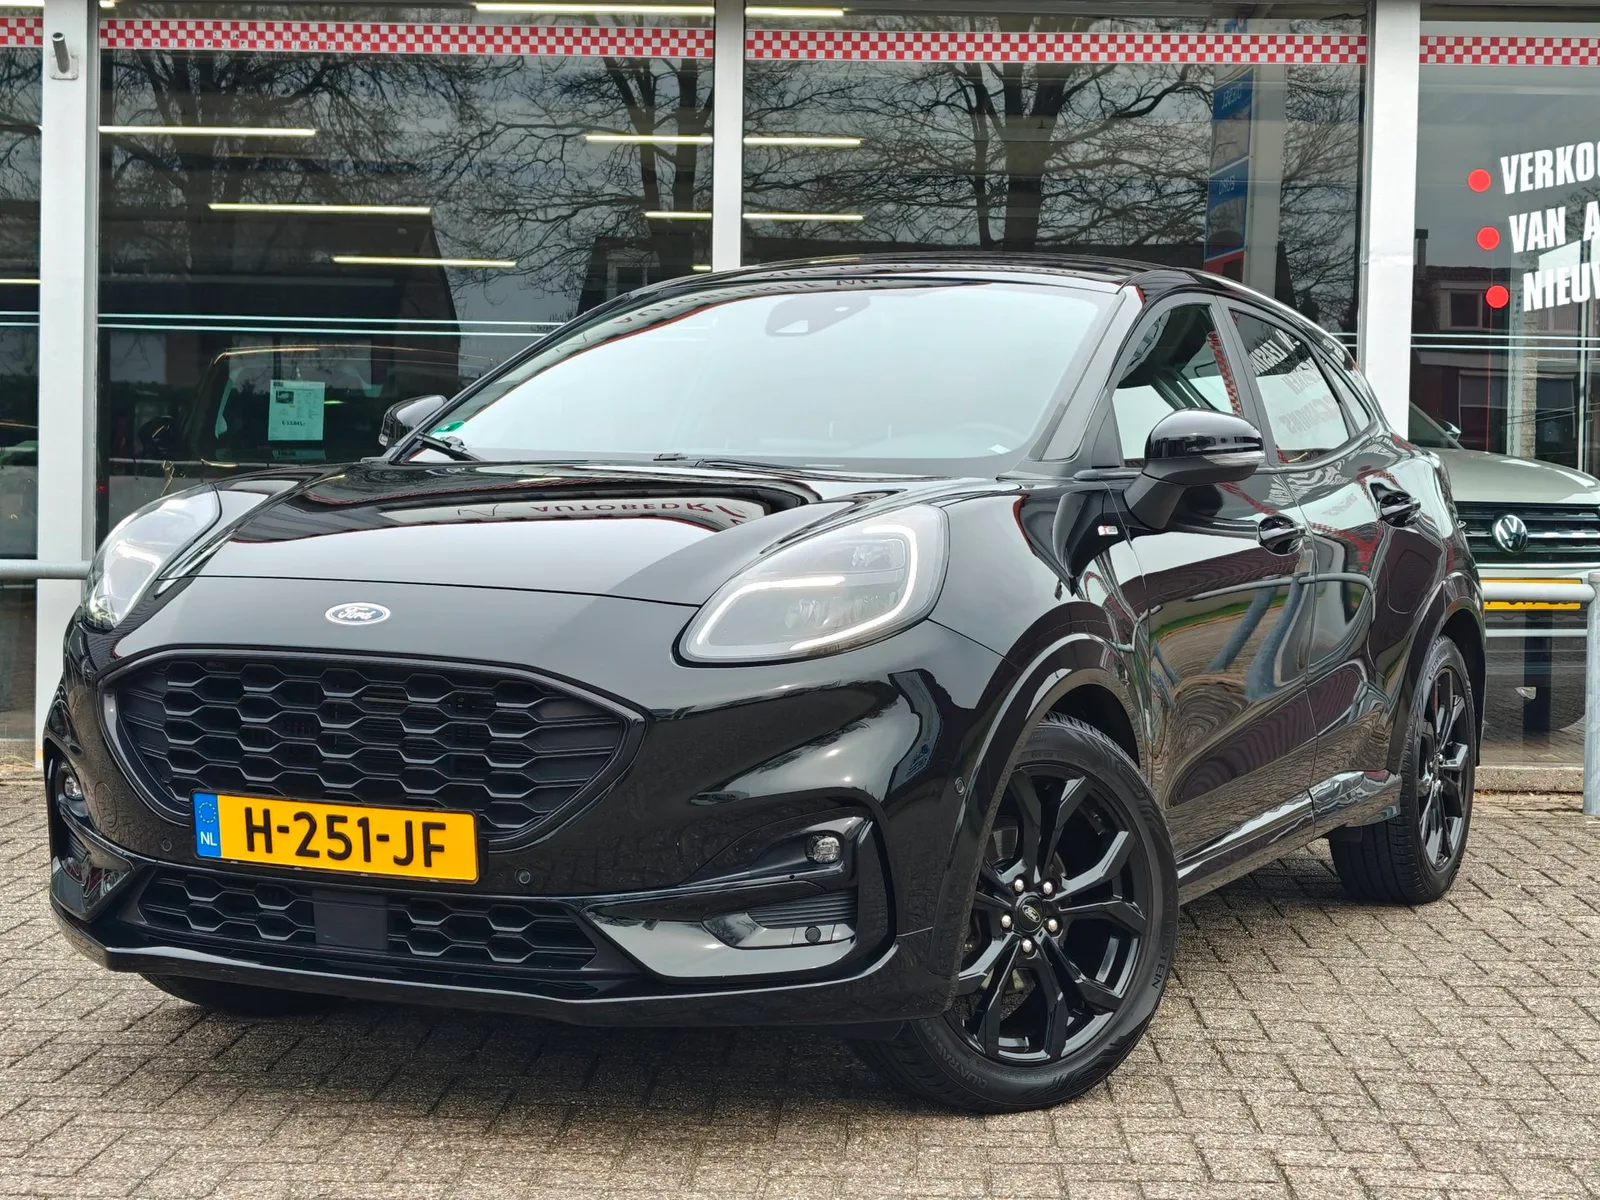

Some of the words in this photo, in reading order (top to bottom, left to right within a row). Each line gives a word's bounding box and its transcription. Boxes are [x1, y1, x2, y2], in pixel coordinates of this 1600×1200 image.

[1500, 140, 1600, 195] VERKO
[1509, 206, 1567, 253] VAN
[200, 831, 218, 847] NL
[244, 806, 447, 868] H-251-JF
